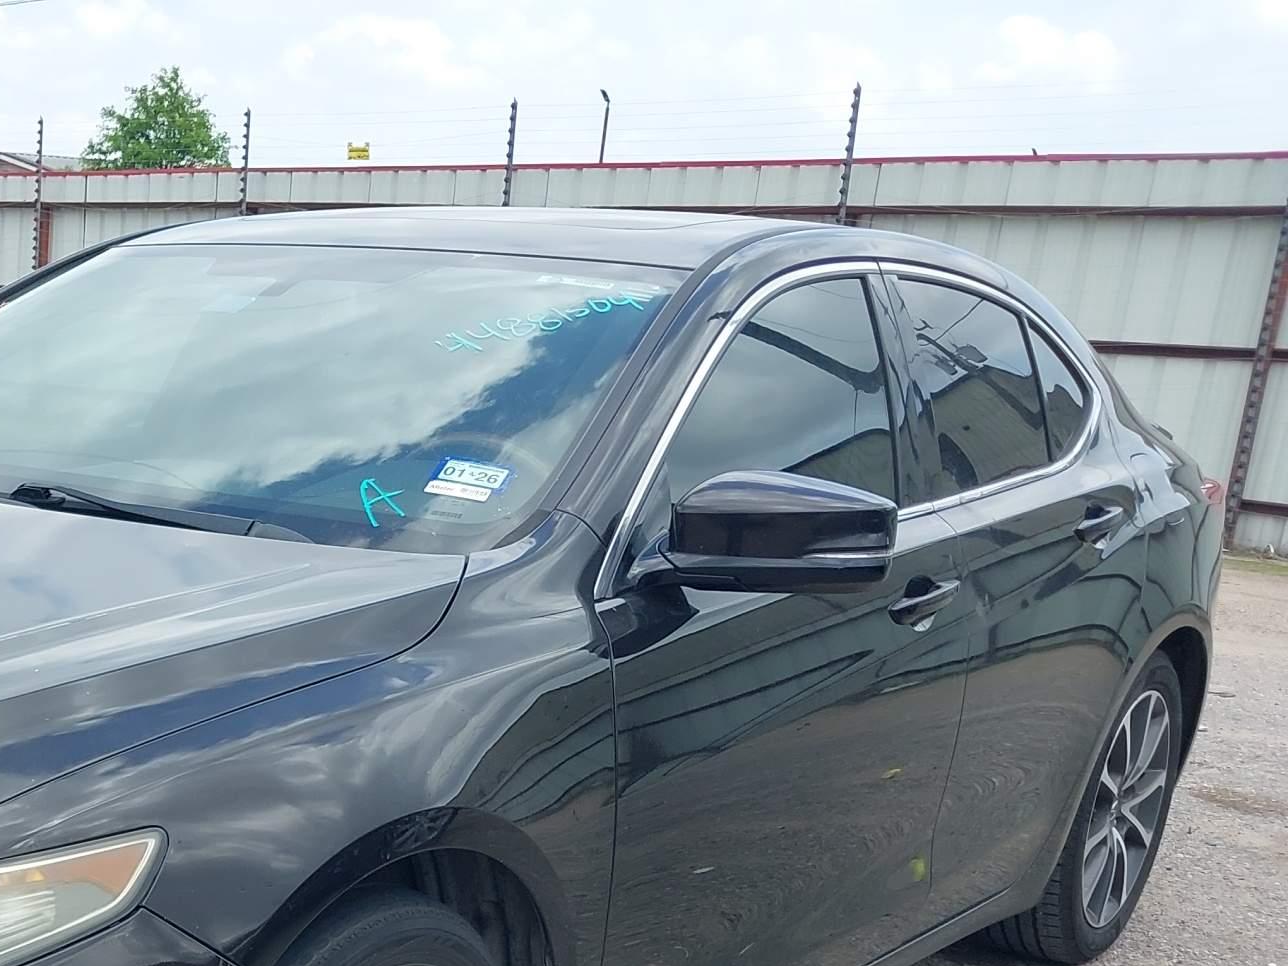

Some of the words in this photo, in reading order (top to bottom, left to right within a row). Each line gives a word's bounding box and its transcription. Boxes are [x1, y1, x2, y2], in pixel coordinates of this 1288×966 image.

[443, 466, 466, 478] 01
[474, 471, 500, 484] 26
[360, 478, 406, 528] A
